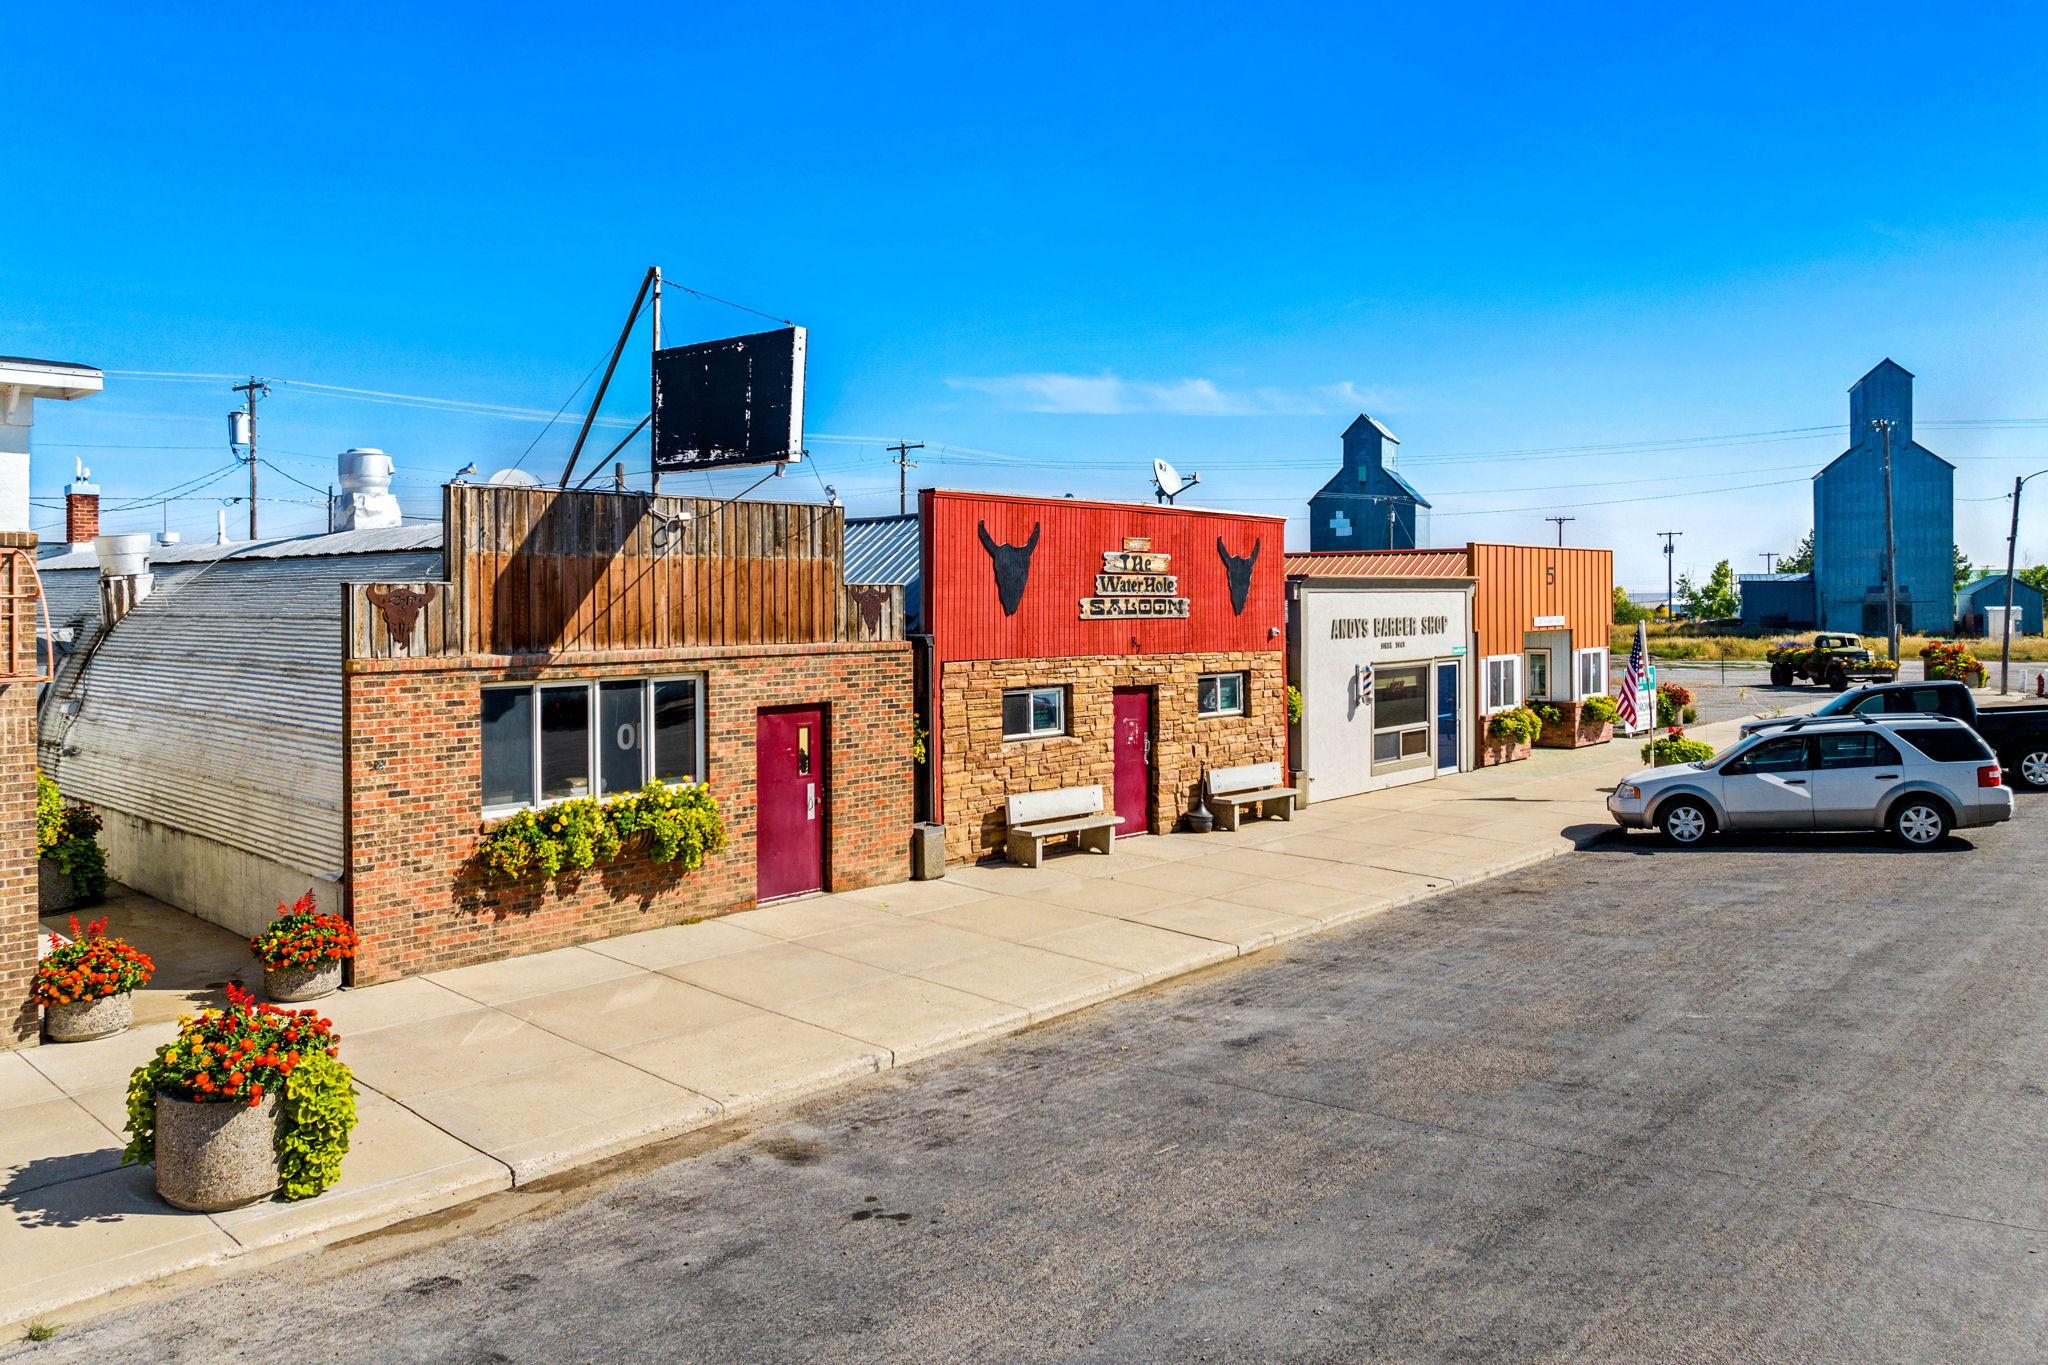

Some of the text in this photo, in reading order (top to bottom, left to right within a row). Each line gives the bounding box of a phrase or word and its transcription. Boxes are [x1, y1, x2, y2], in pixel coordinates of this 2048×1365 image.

[1089, 598, 1184, 616] SALOON
[1373, 616, 1418, 637] BARBER
[1421, 615, 1448, 635] SHOP
